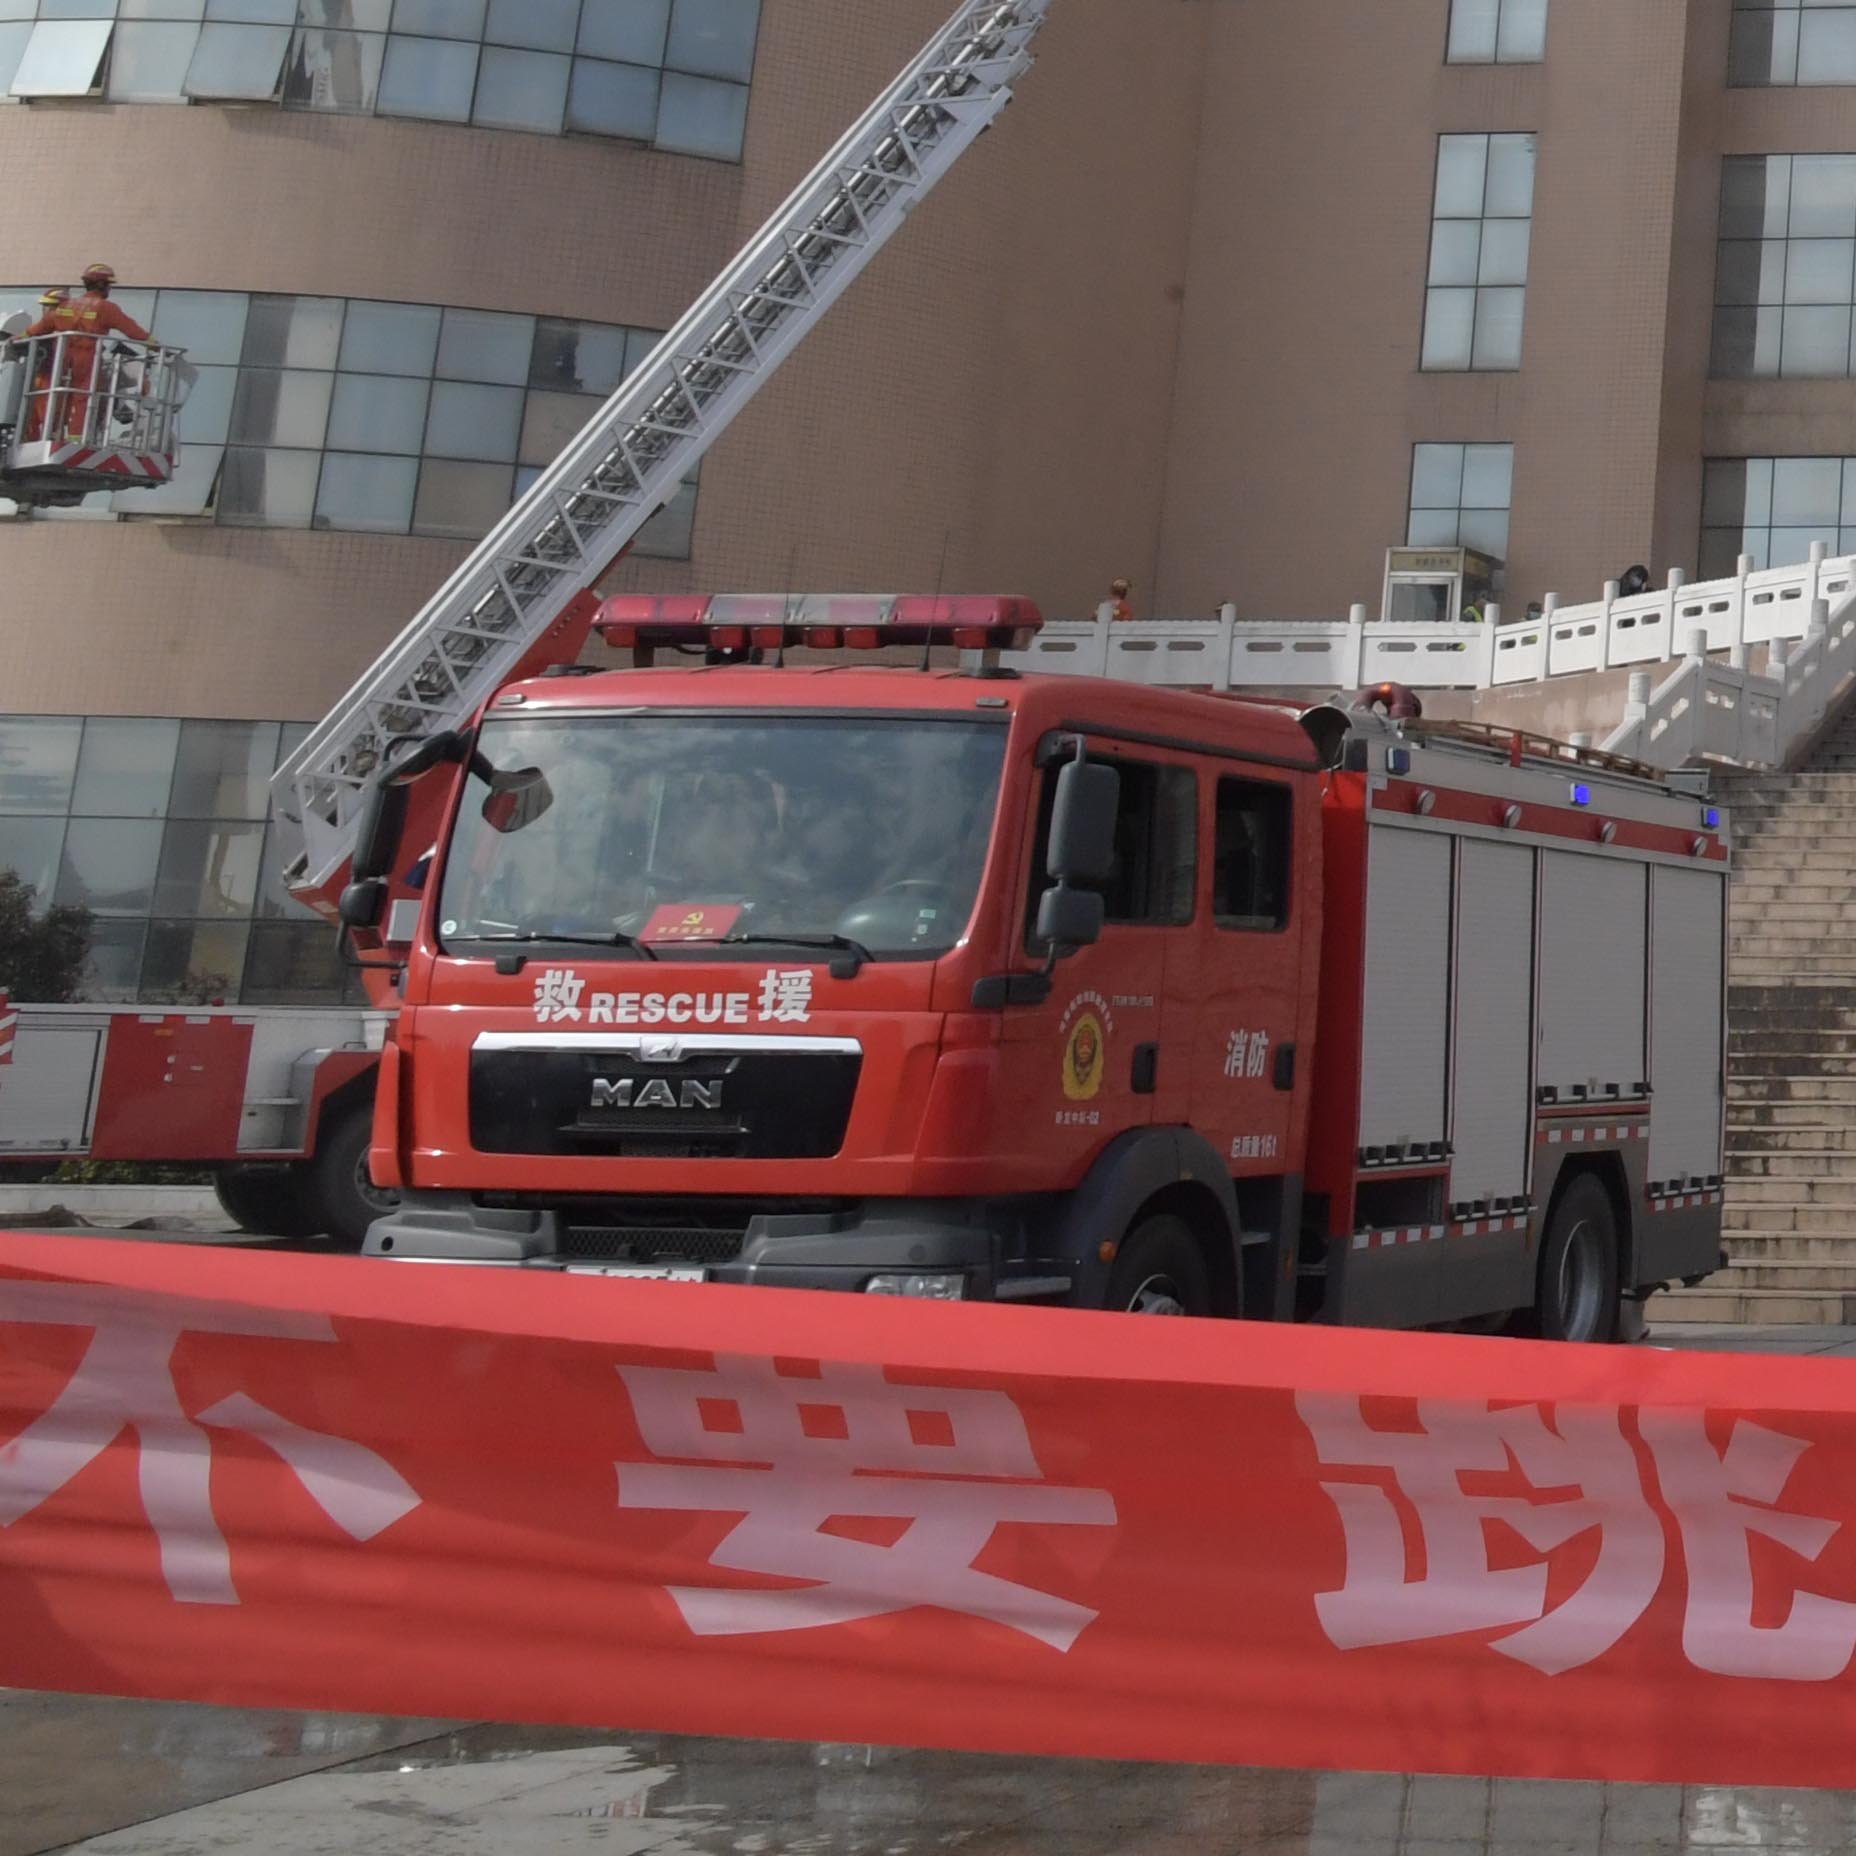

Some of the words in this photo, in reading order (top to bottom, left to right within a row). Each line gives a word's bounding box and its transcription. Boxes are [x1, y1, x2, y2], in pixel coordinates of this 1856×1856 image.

[533, 969, 586, 1024] 救
[588, 991, 751, 1024] RESCUE
[757, 968, 814, 1024] 援
[1223, 1028, 1270, 1078] 消防
[589, 1077, 724, 1110] MAN
